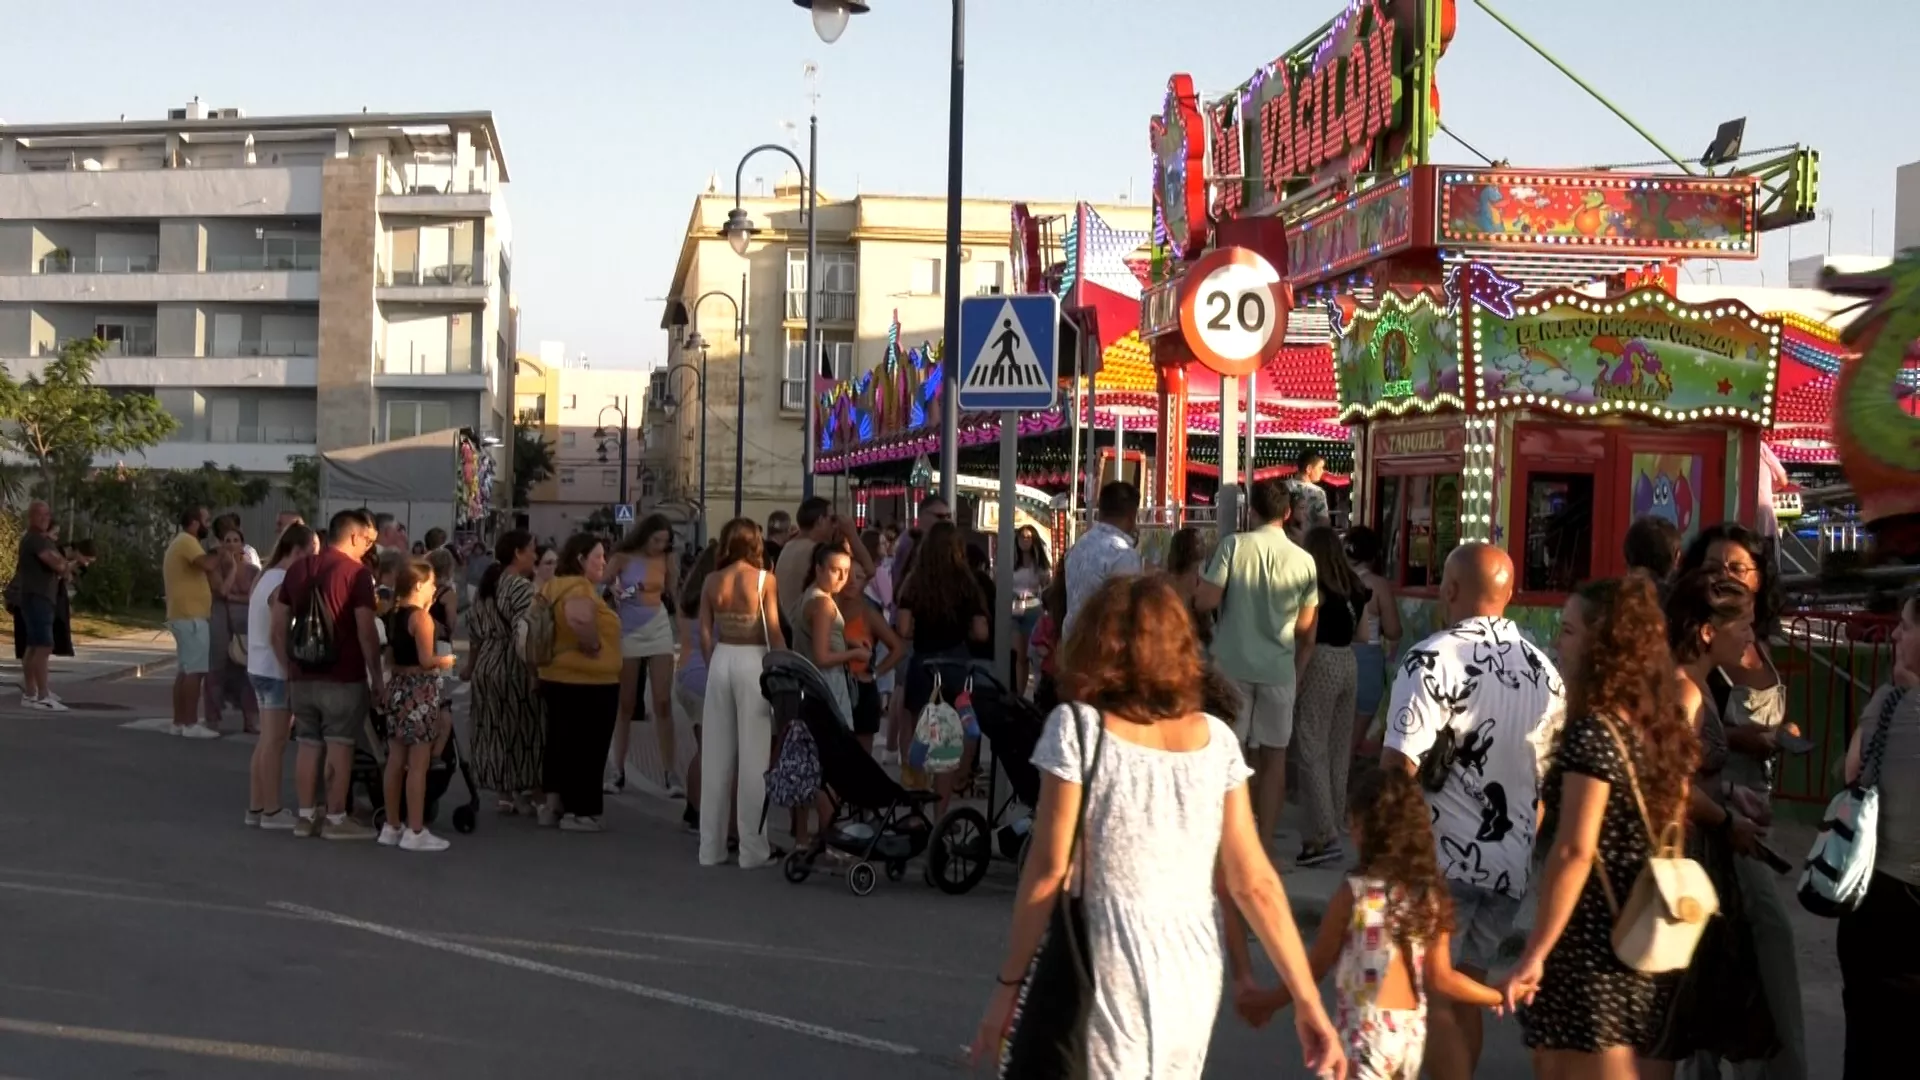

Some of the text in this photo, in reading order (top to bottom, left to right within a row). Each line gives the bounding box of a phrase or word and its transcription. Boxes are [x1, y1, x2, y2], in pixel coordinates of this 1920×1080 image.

[1206, 291, 1265, 333] 20
[1539, 318, 1597, 341] NUEVO
[1388, 431, 1446, 454] TAQUILLA
